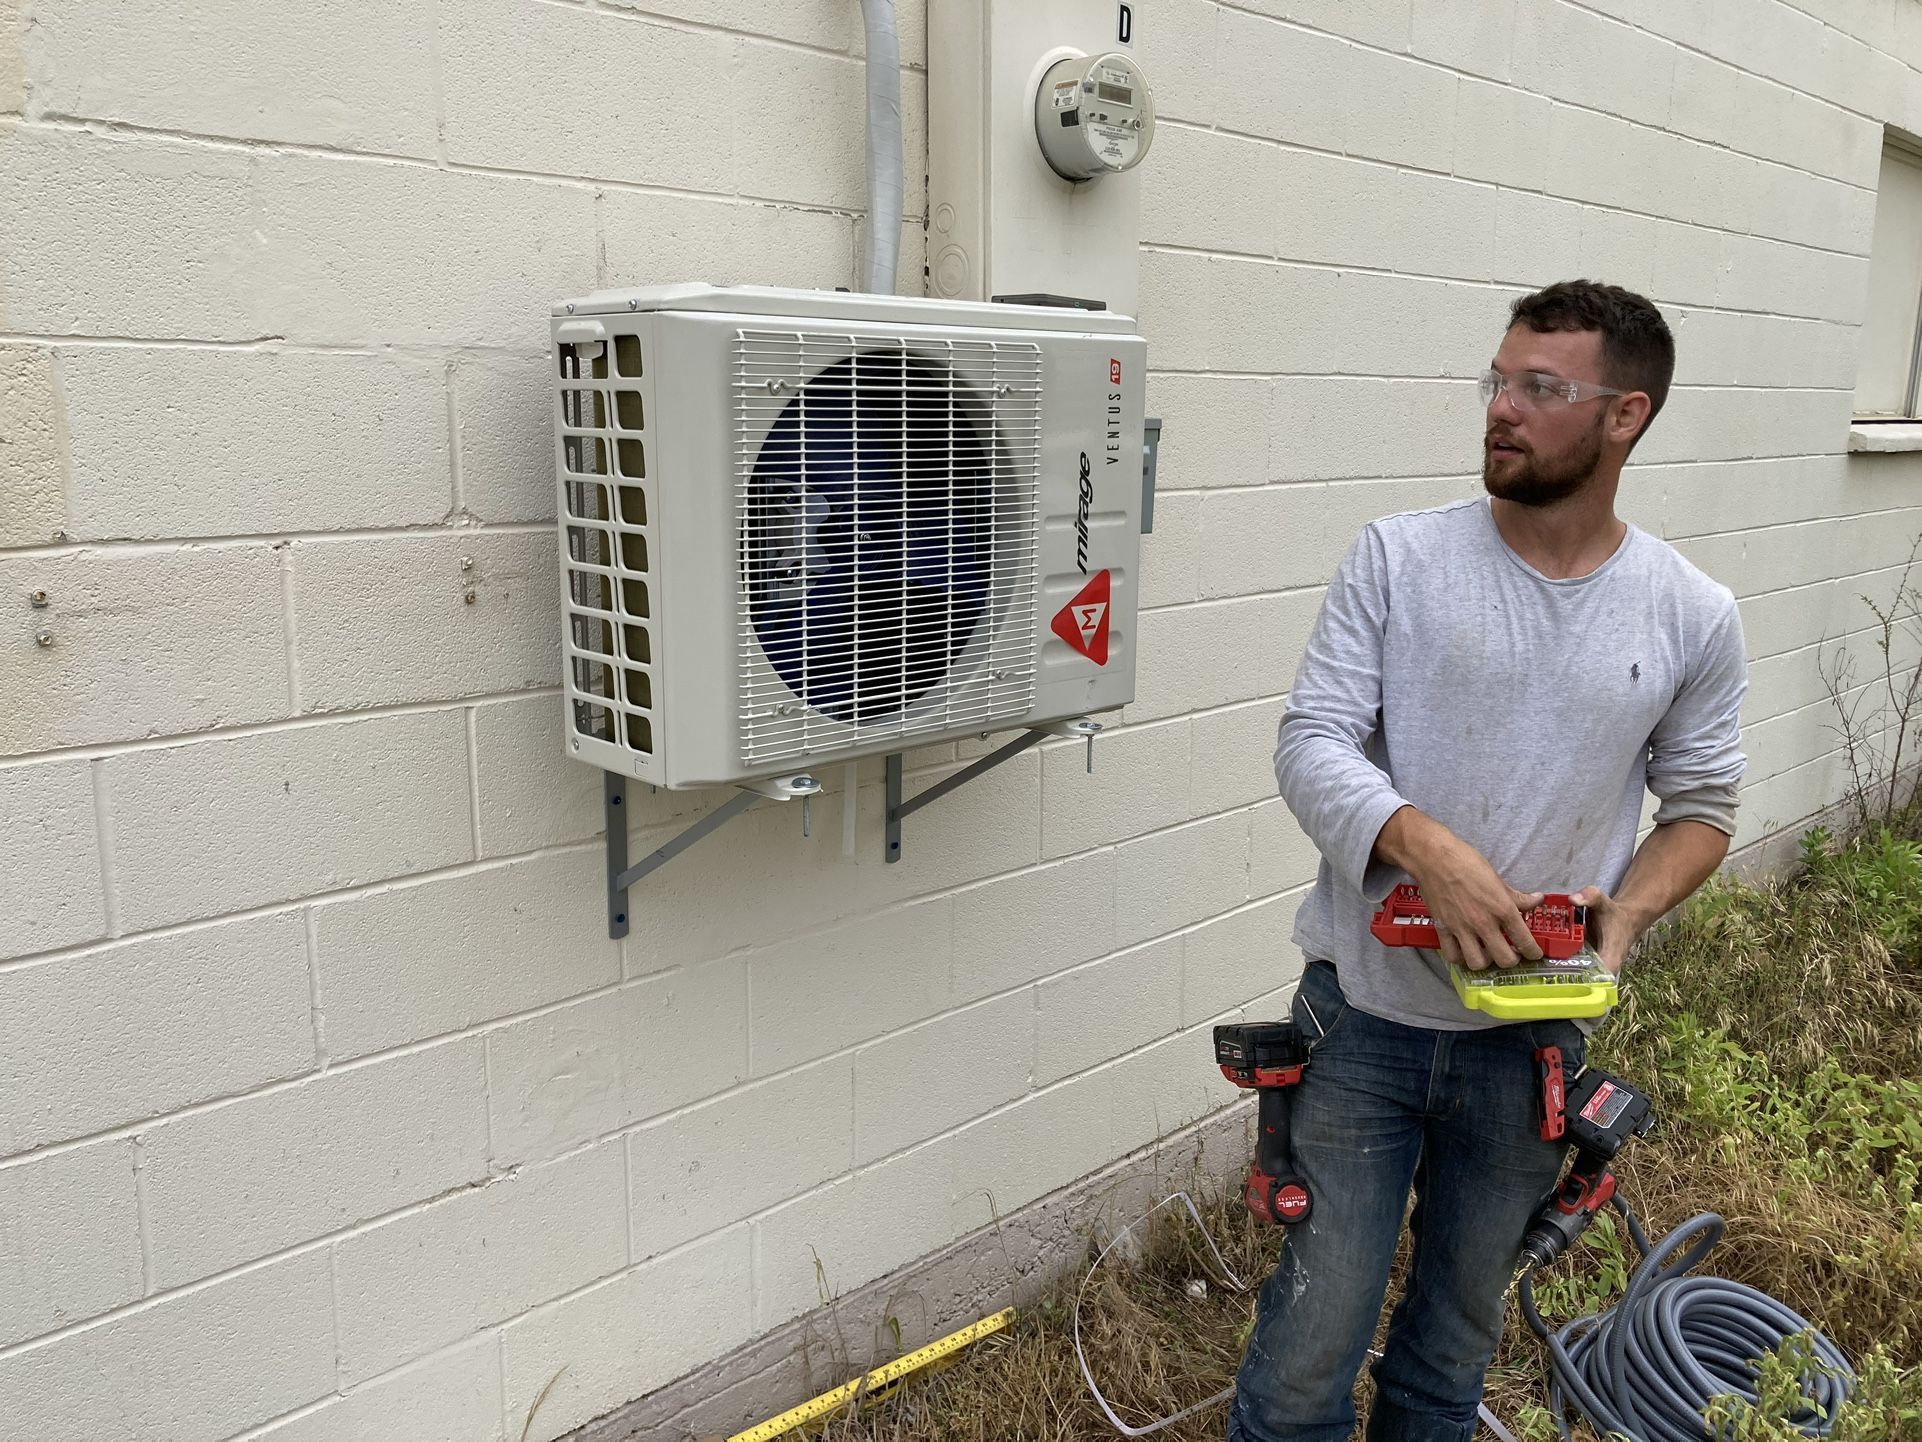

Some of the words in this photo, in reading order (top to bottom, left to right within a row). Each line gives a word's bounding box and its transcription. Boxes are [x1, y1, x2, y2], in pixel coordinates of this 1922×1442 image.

[1118, 4, 1132, 43] D
[1111, 363, 1120, 382] 19
[1106, 393, 1121, 465] VENTUS
[1073, 451, 1093, 576] mirage
[1081, 608, 1097, 631] M
[1278, 1199, 1307, 1208] FUEL
